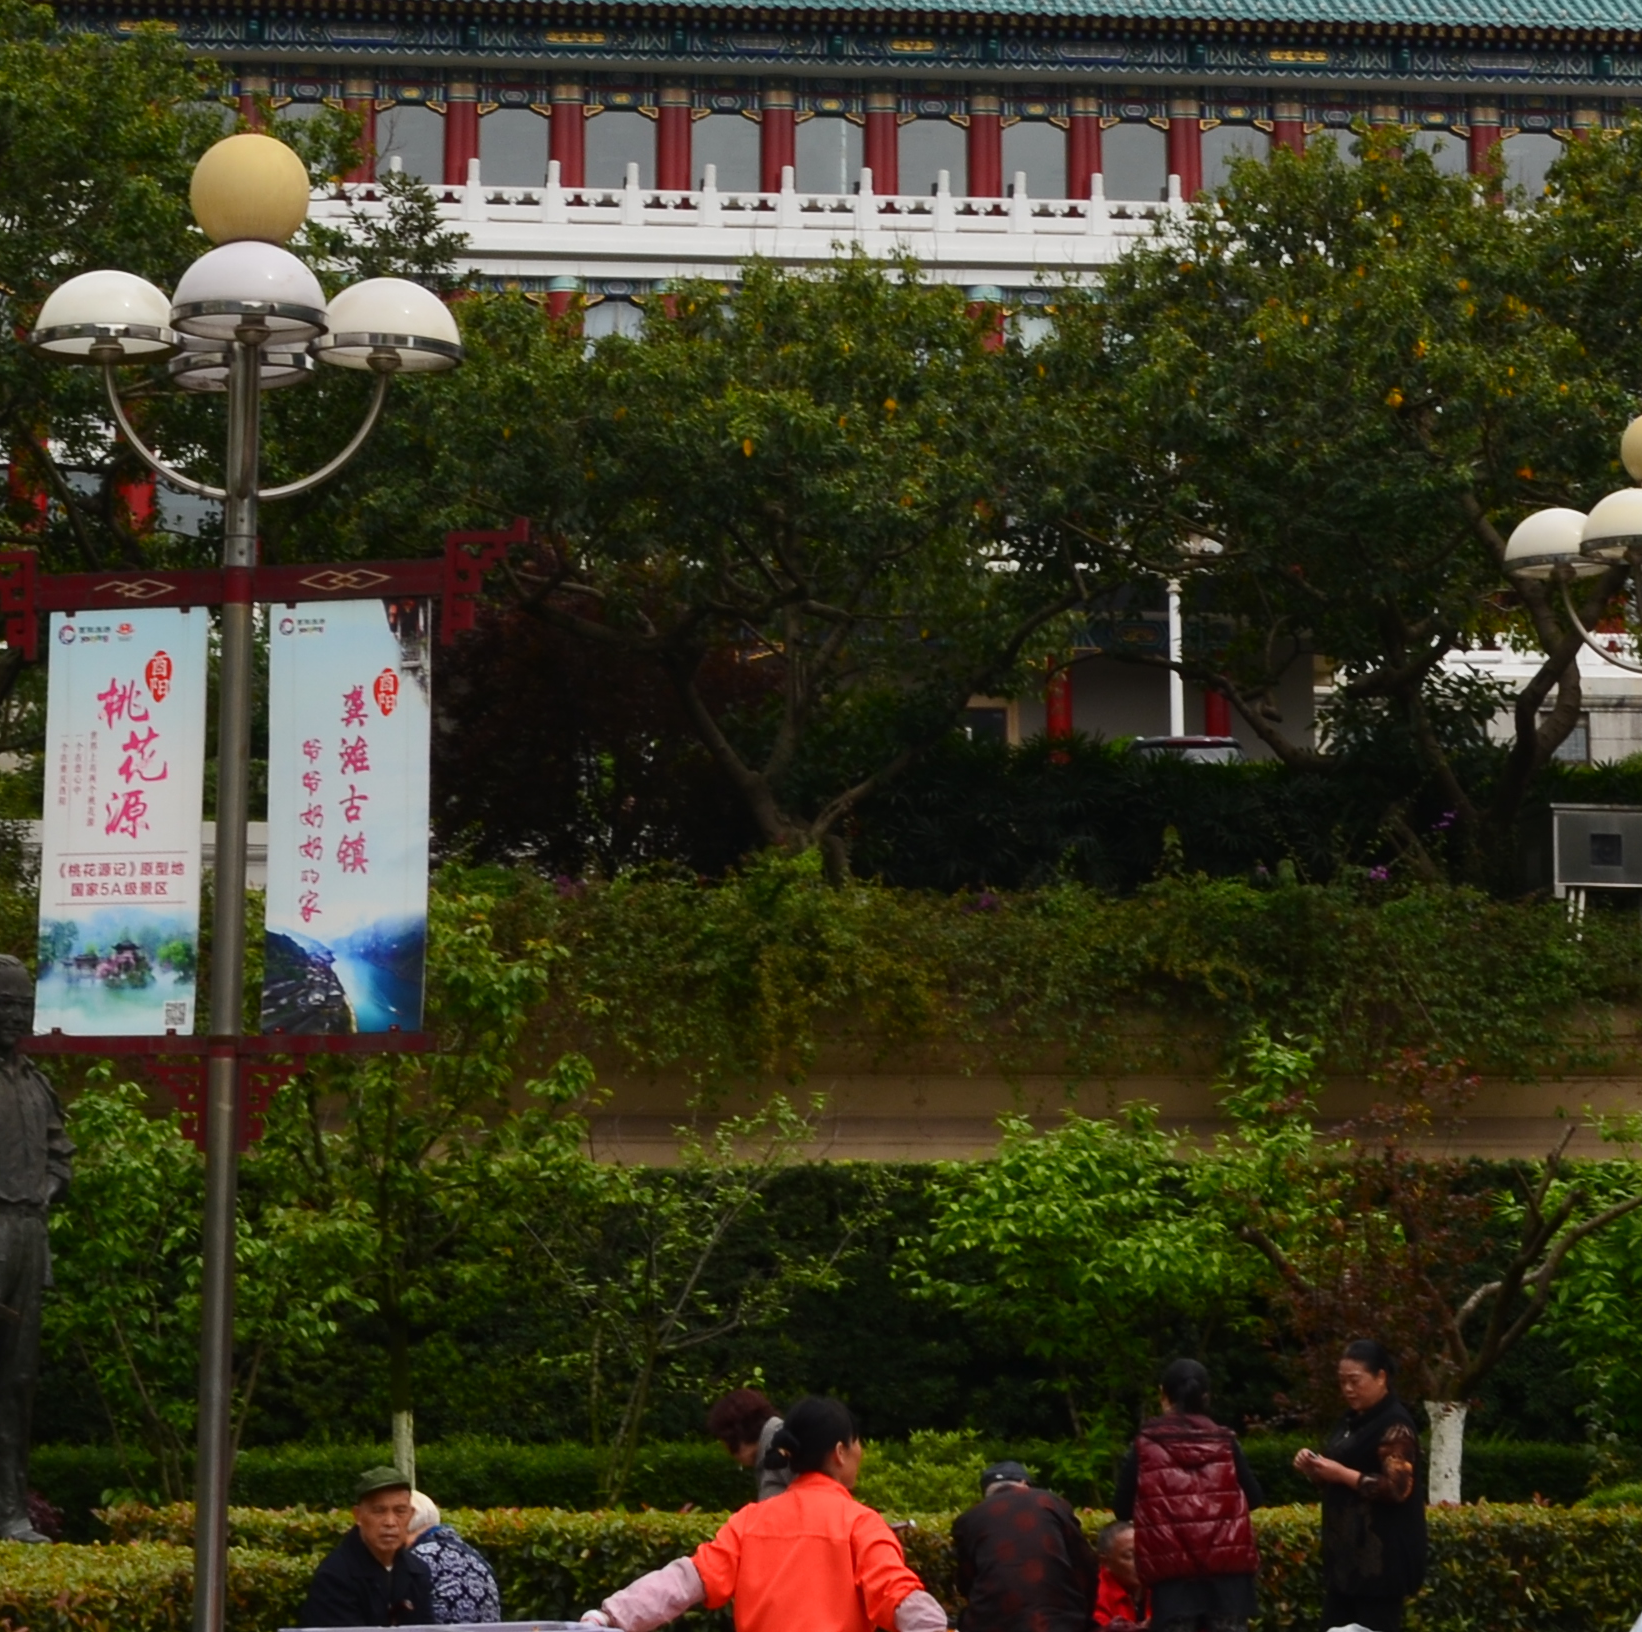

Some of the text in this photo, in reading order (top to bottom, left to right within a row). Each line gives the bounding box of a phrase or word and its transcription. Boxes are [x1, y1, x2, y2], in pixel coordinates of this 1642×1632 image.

[149, 654, 171, 697] 酉阳
[378, 673, 397, 711] 酉阳
[96, 676, 169, 840] 桃花源
[336, 684, 371, 874] 龚滩古镇
[298, 738, 324, 923] 爷爷奶奶的家
[59, 860, 186, 879] 《桃花源记》原型地
[70, 881, 169, 897] 国家5A级景区
